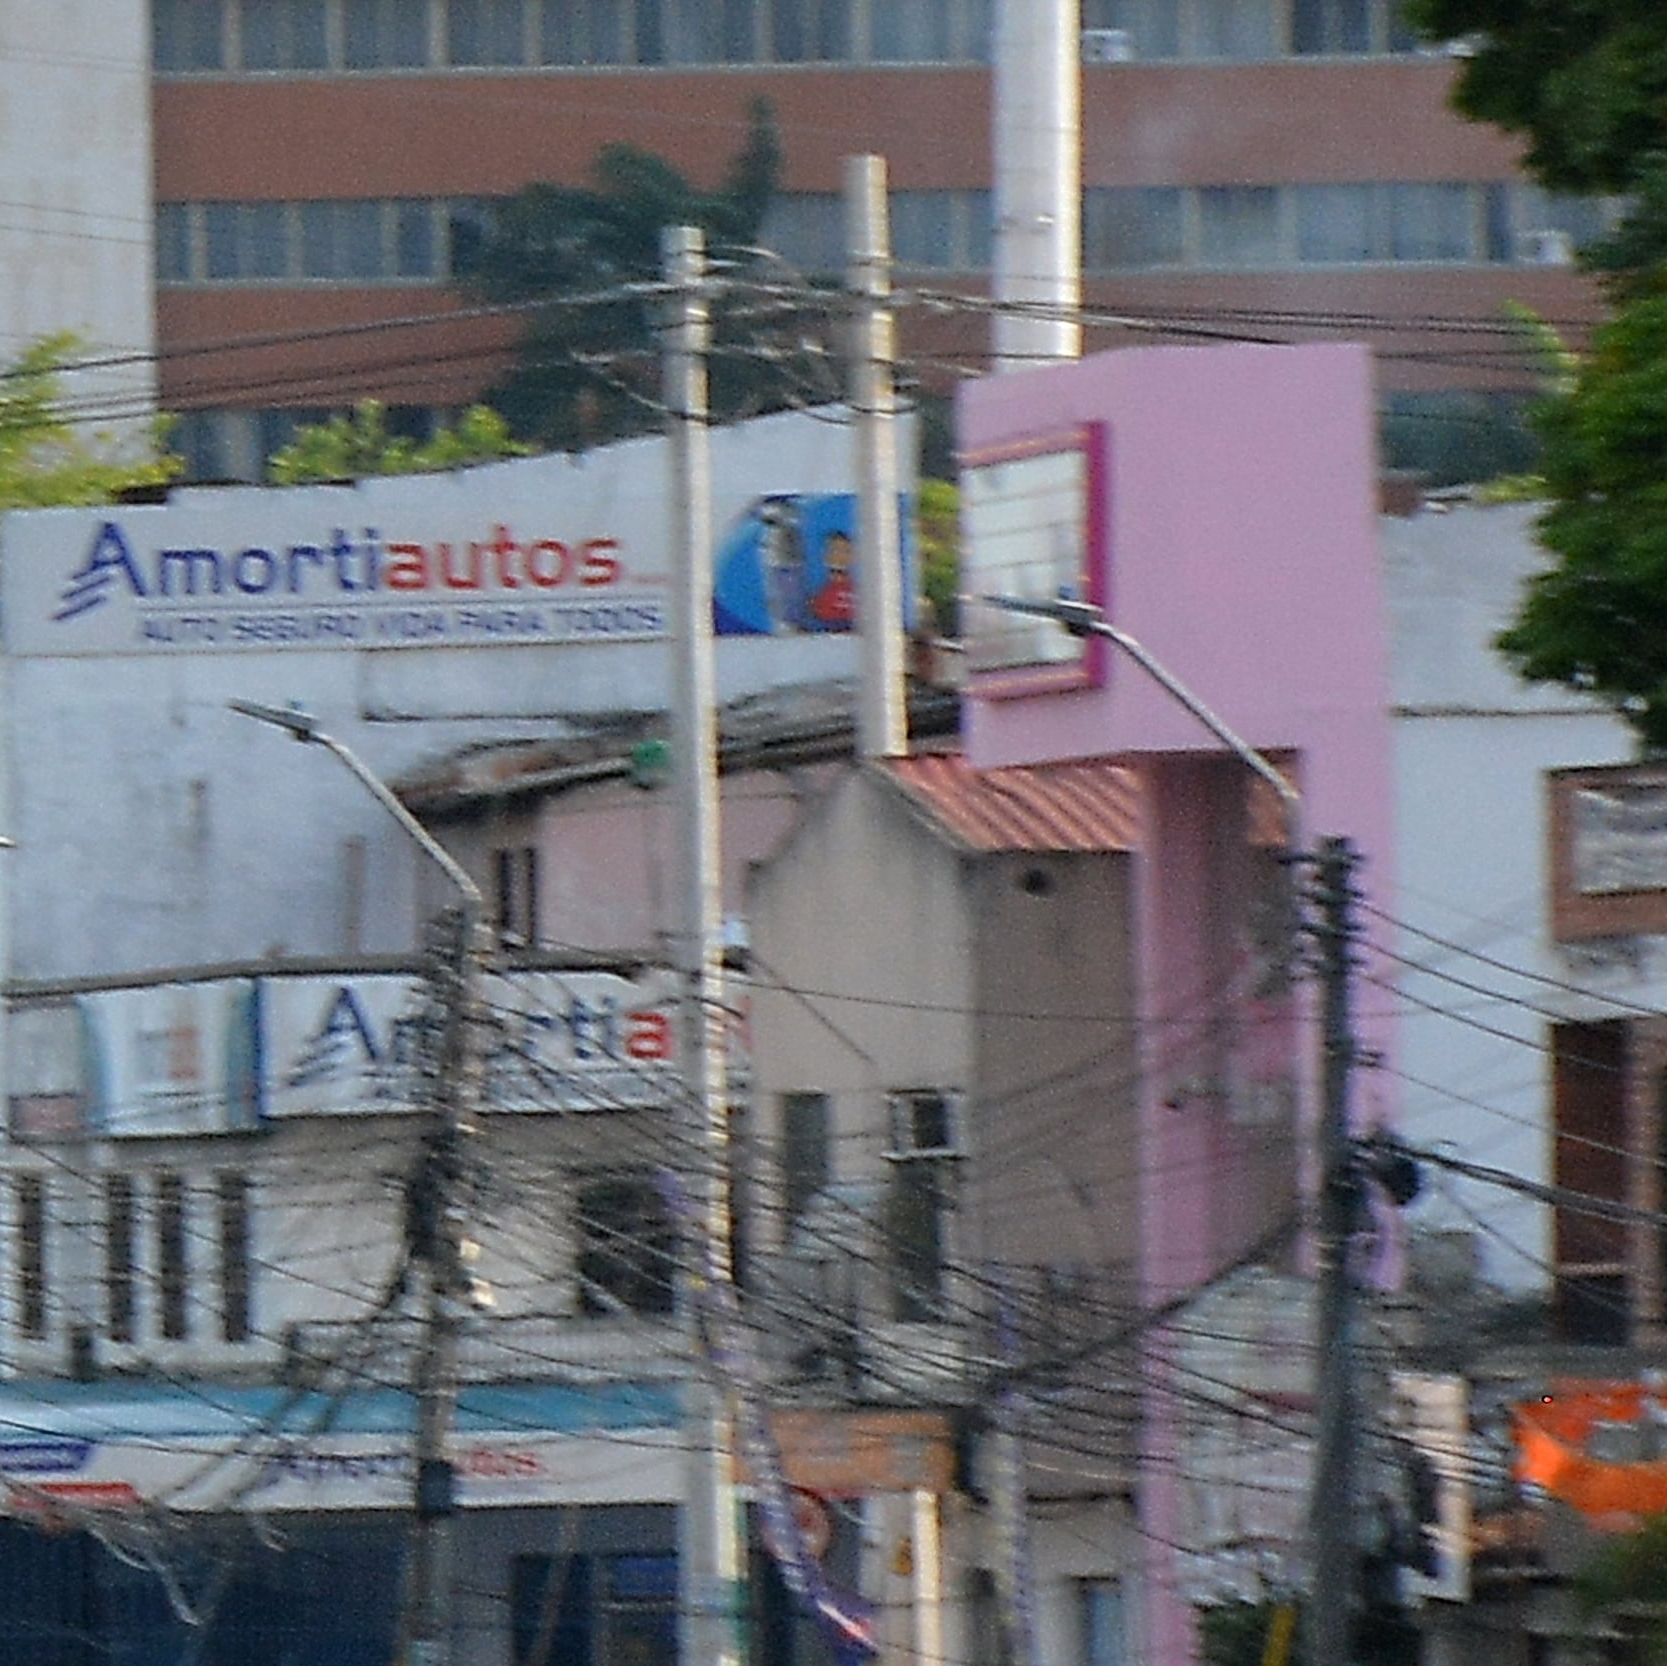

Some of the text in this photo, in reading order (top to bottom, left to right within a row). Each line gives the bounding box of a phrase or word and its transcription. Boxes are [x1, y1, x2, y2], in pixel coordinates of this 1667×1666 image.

[55, 520, 624, 618] Amortiautos
[141, 604, 663, 643] AUTO SEGURO VIDA PARA TODOS
